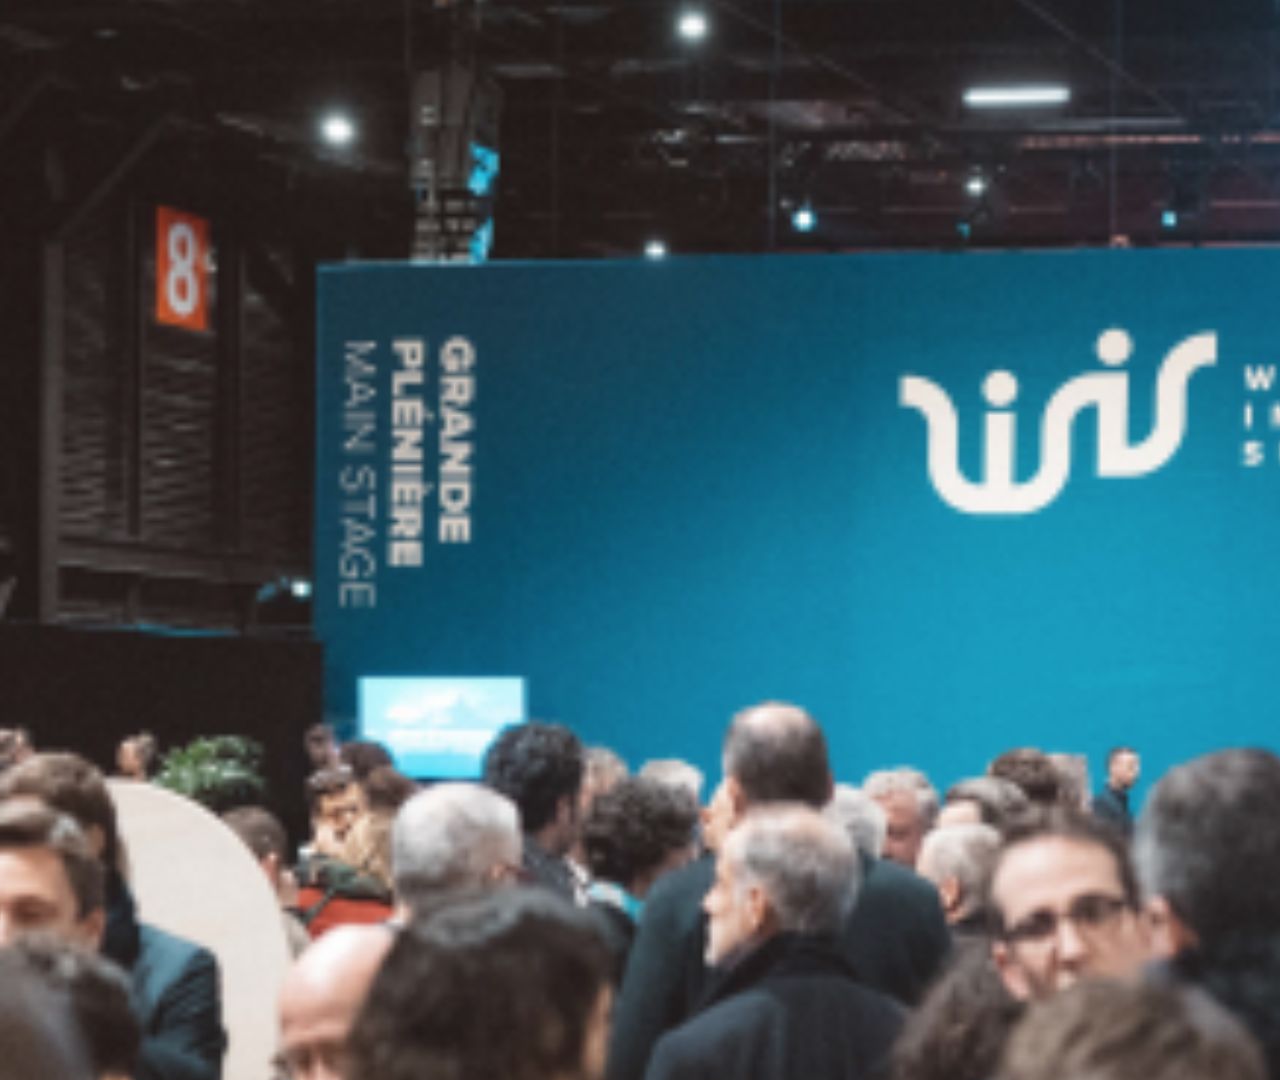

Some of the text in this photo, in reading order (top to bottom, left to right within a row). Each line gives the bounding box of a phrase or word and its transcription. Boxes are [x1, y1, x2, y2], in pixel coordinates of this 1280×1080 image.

[166, 220, 200, 317] 8
[339, 340, 377, 609] MAIN STAGE
[387, 338, 434, 567] PLÉNIÈRE
[438, 335, 477, 544] GRANDE
